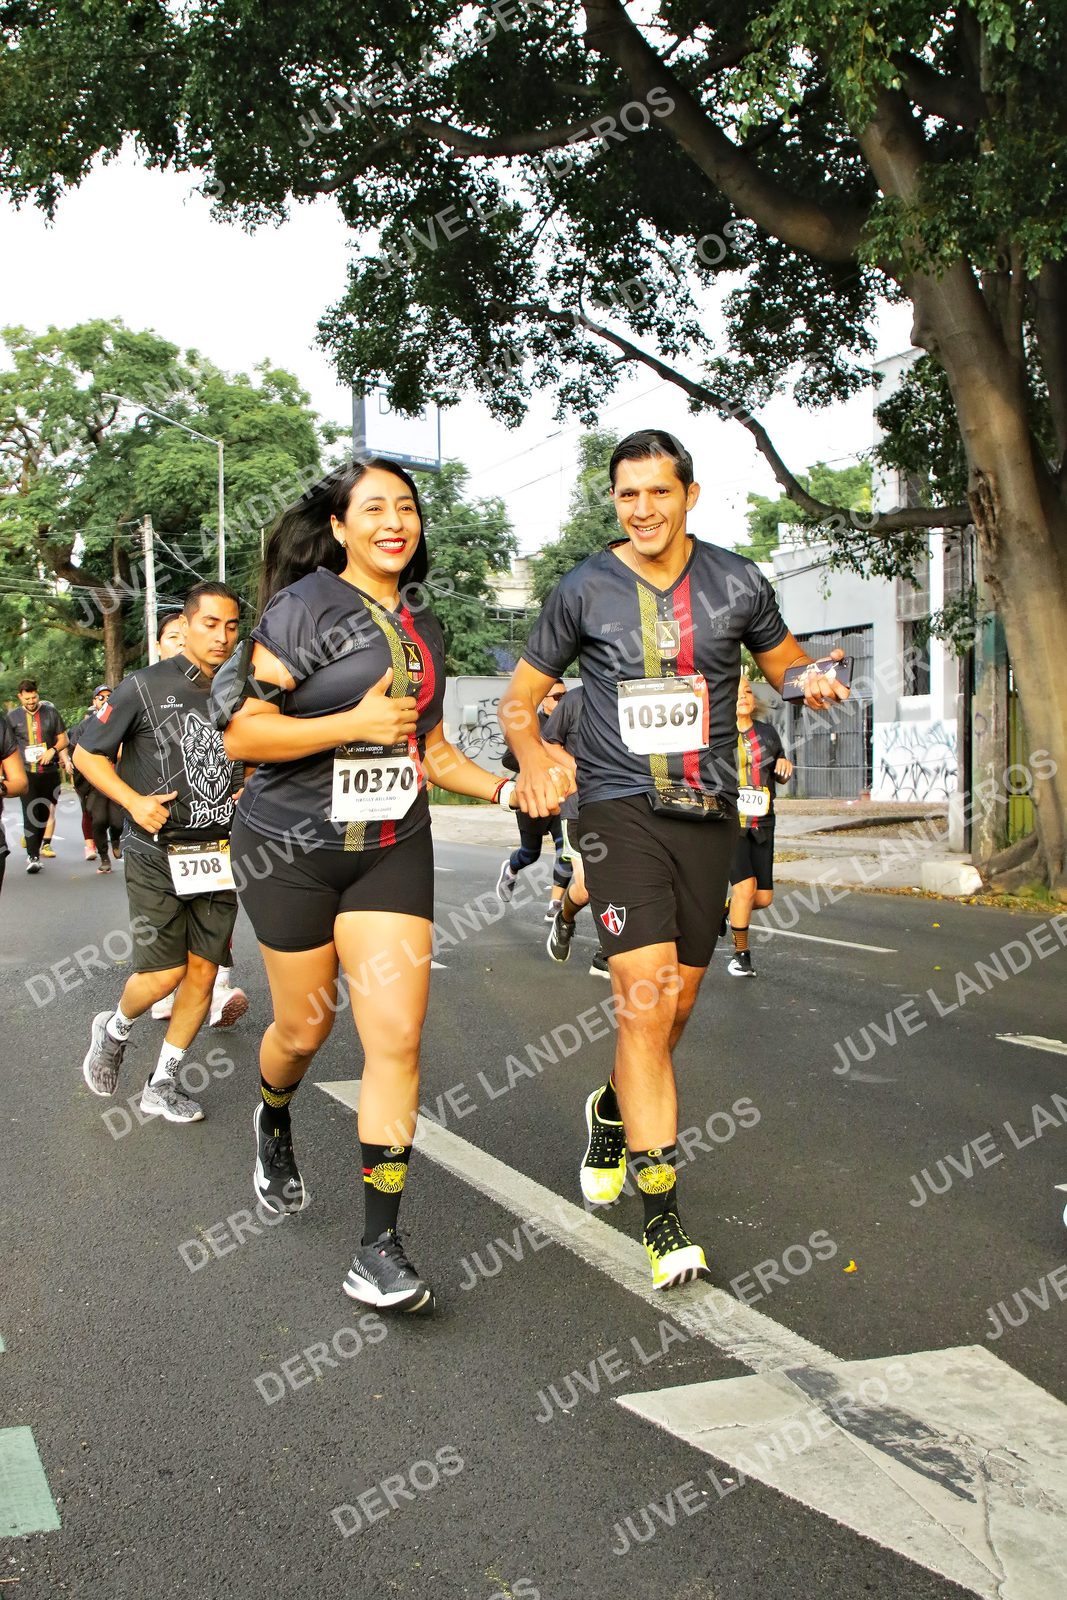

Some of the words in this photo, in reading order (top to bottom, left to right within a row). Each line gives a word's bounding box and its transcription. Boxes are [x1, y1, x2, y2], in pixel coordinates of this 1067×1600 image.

[623, 702, 698, 730] 10369
[339, 766, 414, 794] 10370
[185, 797, 234, 828] JAURÍ
[190, 800, 208, 813] LA
[179, 857, 222, 877] 3708
